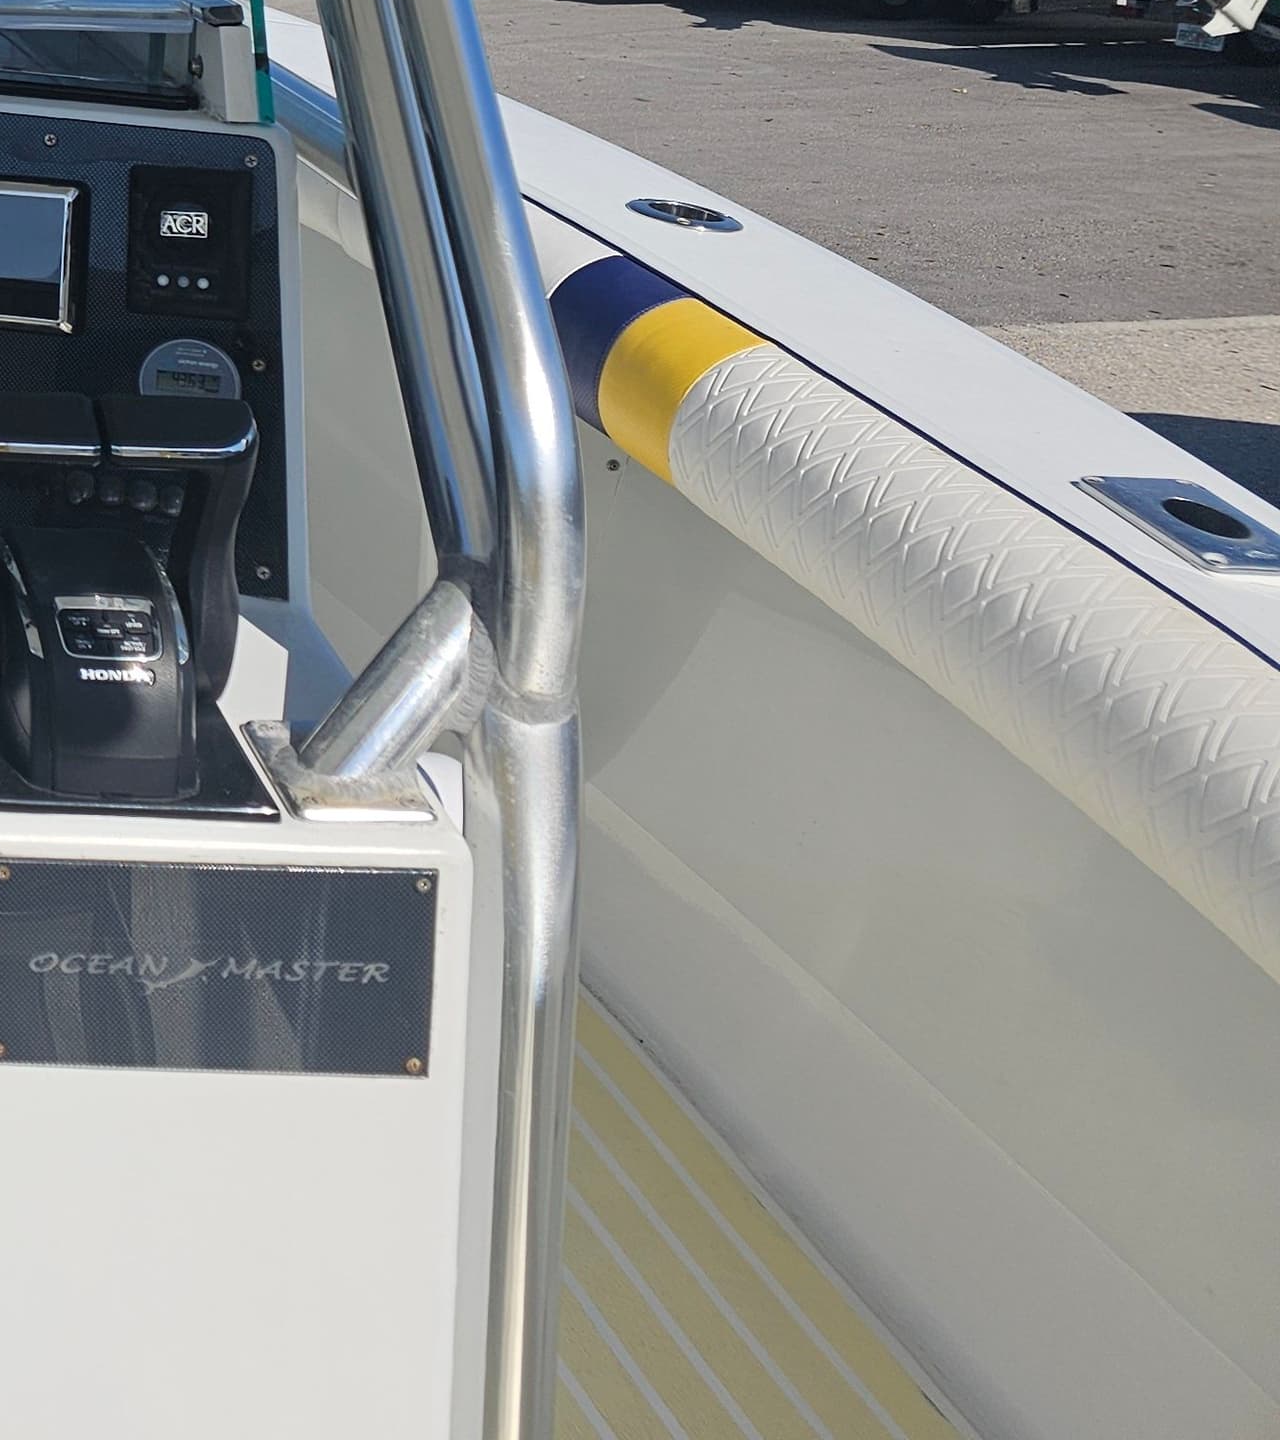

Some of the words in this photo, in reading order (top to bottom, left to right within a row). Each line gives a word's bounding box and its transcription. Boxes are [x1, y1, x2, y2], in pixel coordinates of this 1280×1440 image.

[160, 214, 207, 235] ACR
[79, 667, 155, 686] HONDA
[27, 952, 170, 976] OCEAN
[220, 956, 391, 985] MASTER
